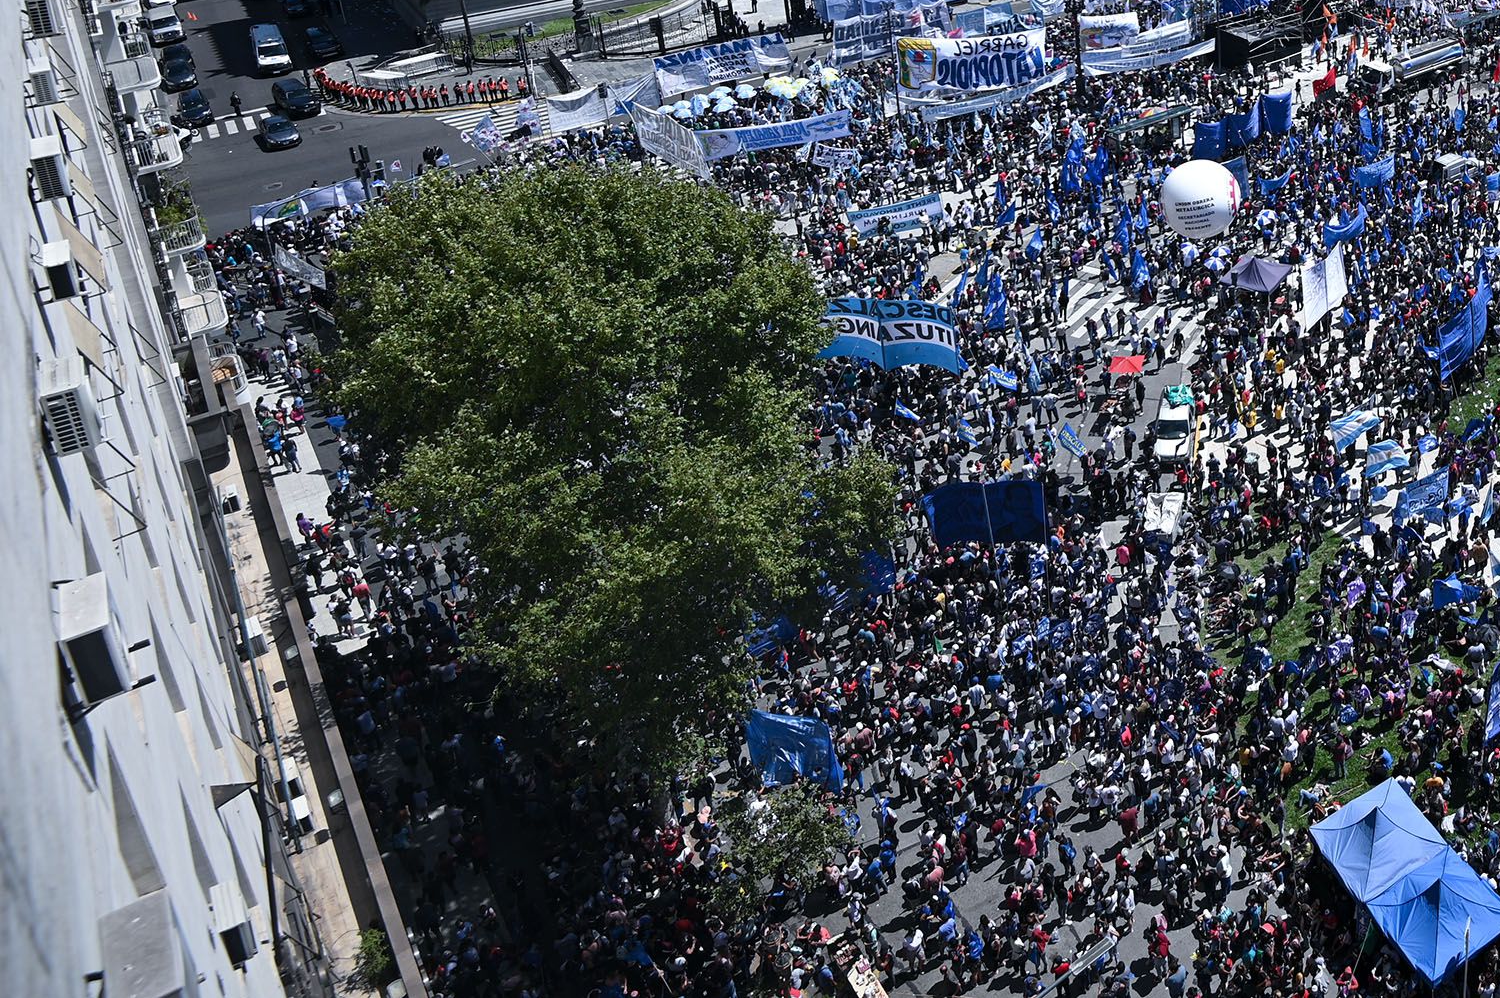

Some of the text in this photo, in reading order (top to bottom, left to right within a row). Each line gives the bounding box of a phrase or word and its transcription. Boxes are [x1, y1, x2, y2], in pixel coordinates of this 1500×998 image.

[1192, 197, 1214, 206] OBRERA
[1176, 203, 1215, 212] METALURGICA
[1178, 210, 1216, 220] SECRETARIADO
